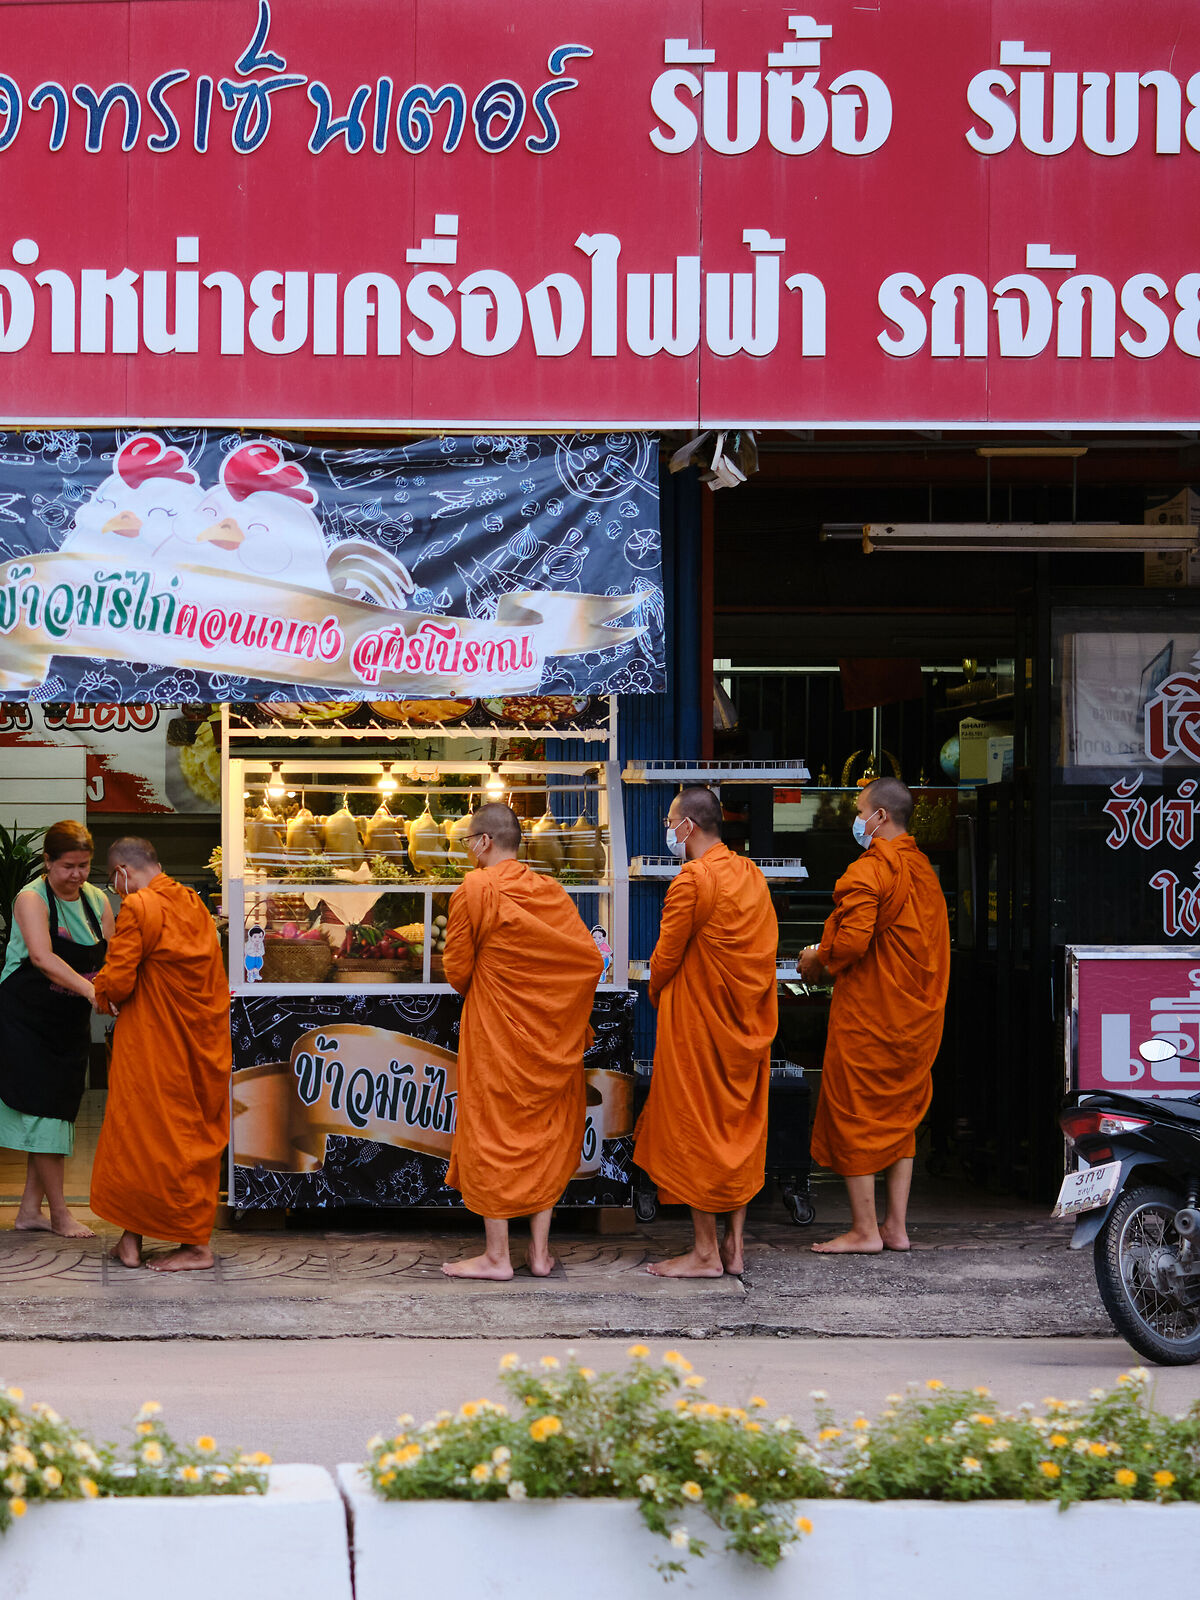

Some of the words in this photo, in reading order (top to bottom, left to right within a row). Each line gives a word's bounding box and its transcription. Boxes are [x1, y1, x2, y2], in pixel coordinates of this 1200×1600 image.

[649, 15, 893, 156] รับซื้อ
[965, 40, 1200, 156] รับขา
[352, 622, 535, 682] สูตรโบราณ
